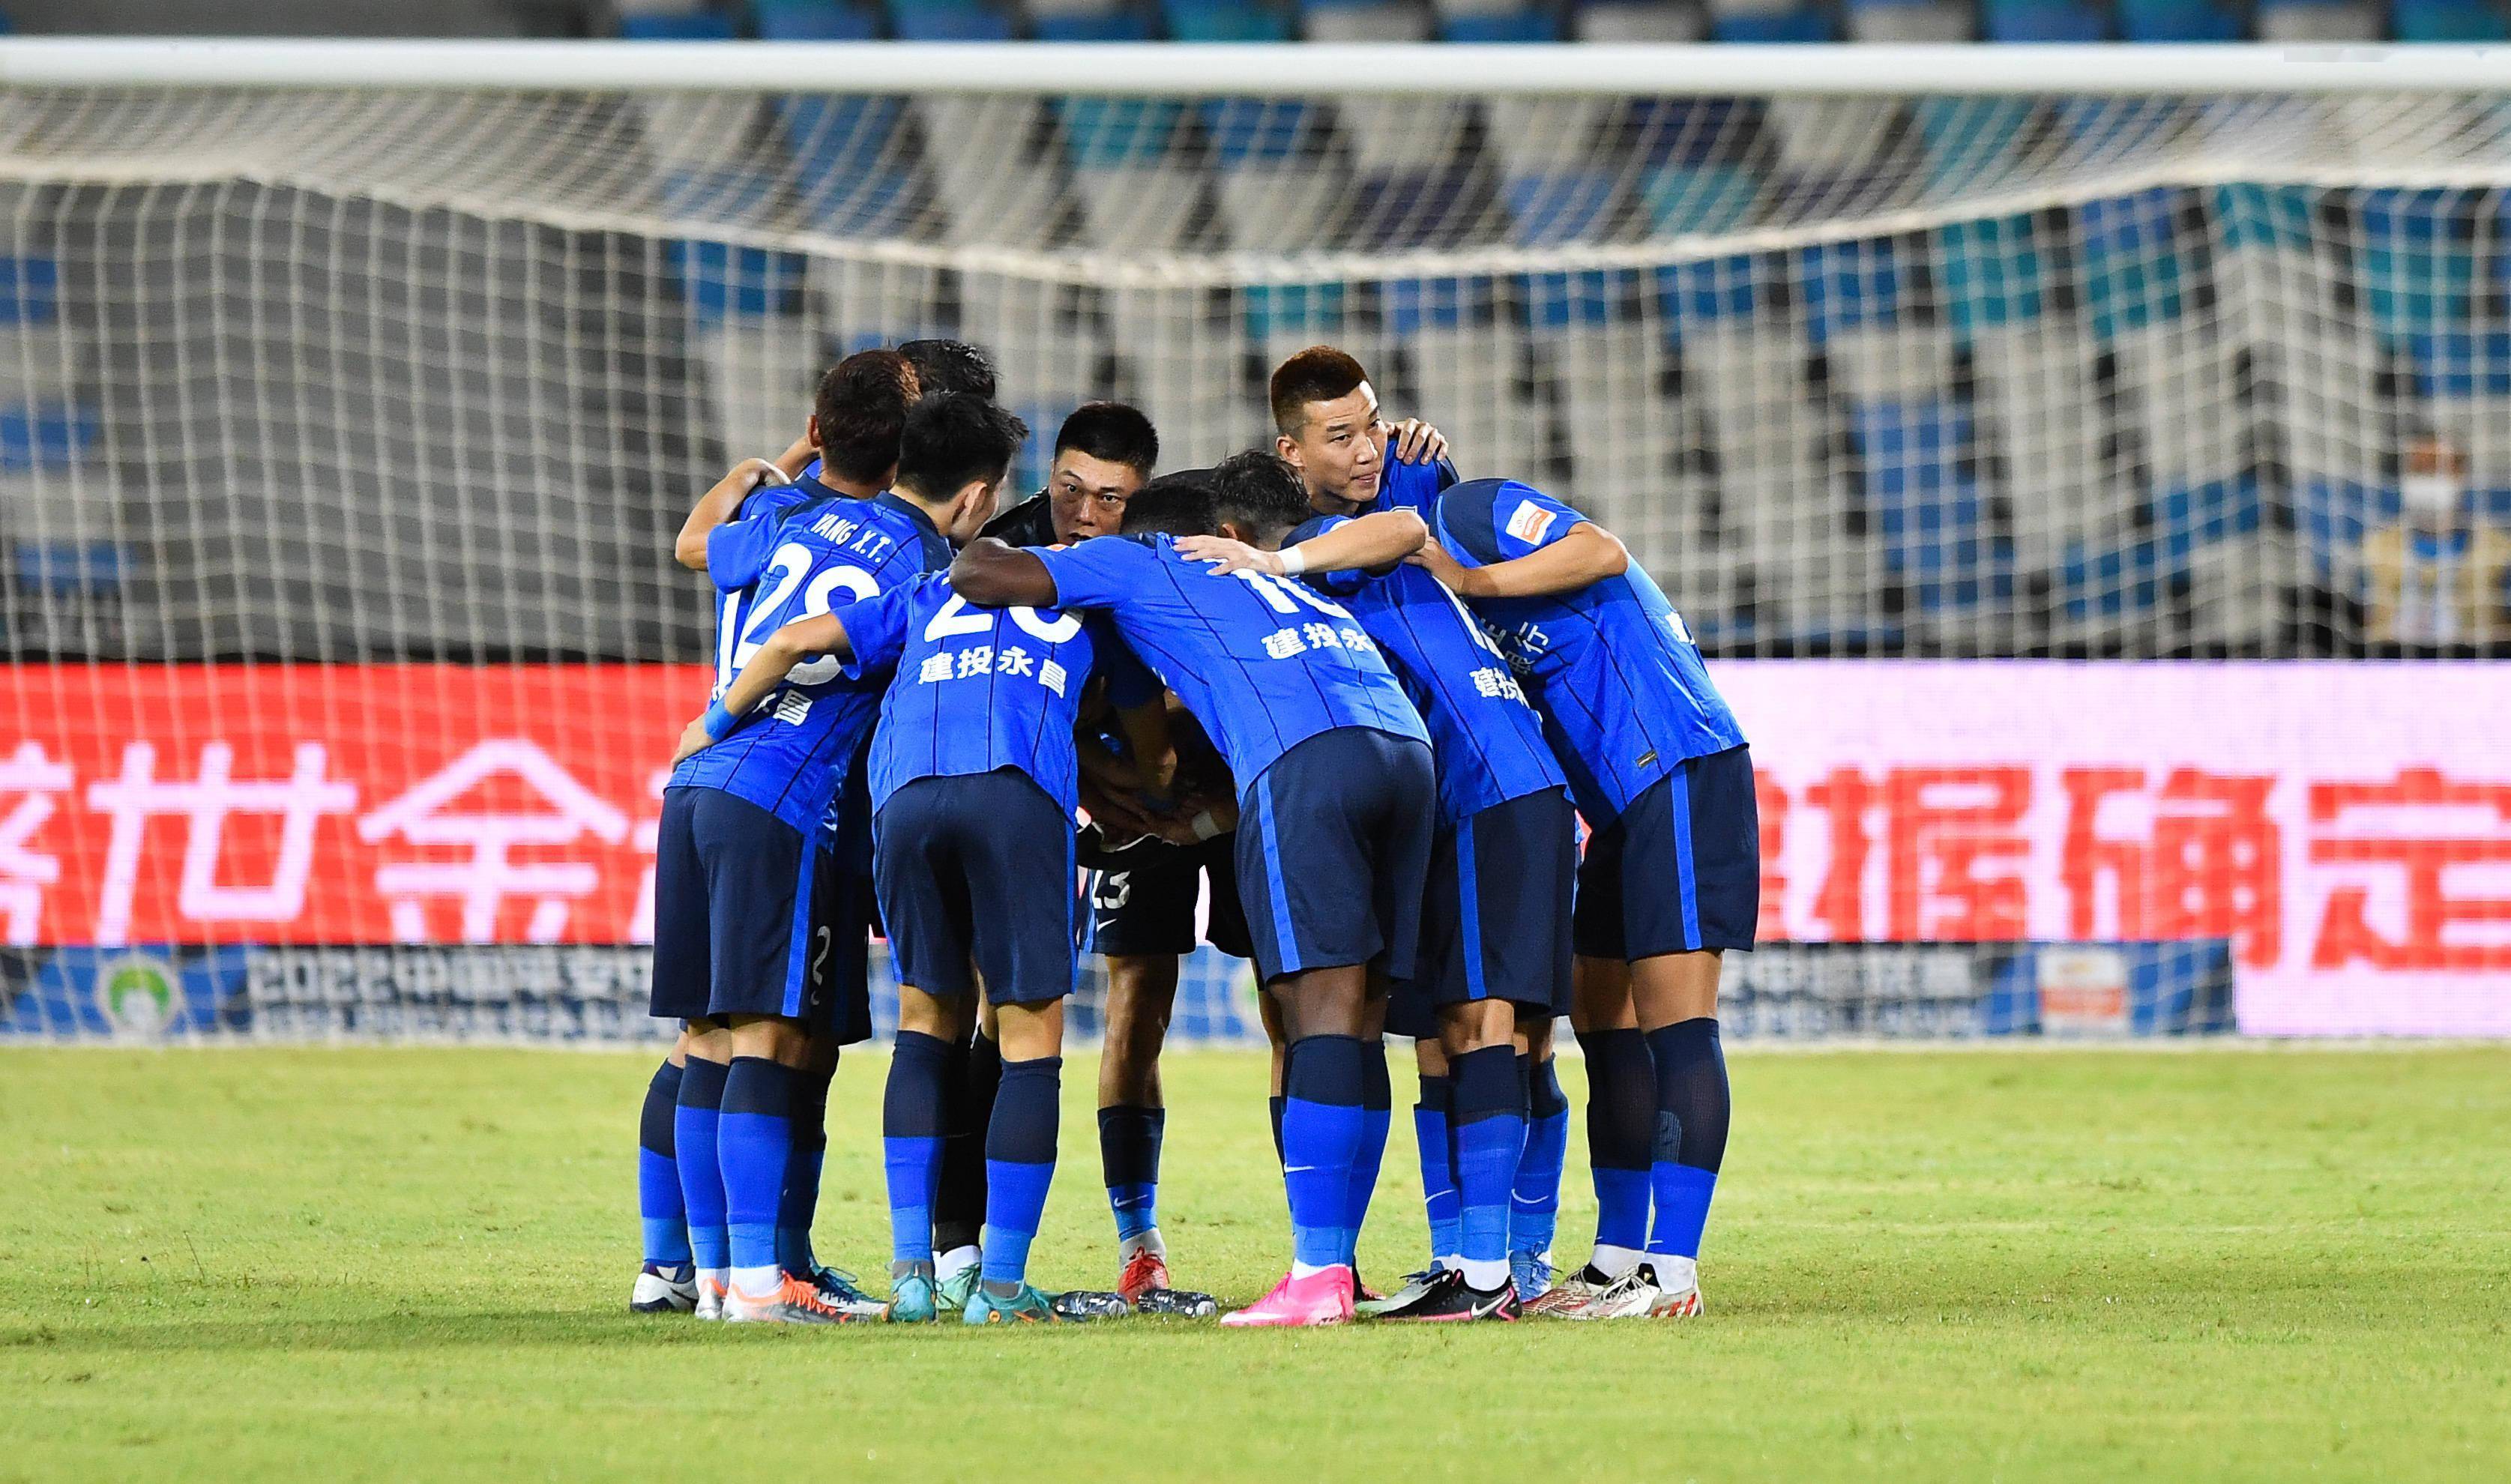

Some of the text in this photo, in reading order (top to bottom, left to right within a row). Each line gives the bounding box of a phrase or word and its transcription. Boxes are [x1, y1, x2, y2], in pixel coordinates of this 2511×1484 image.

[810, 513, 859, 545] YANG
[917, 645, 1067, 699] 建投永昌
[0, 738, 658, 946] 世金
[1754, 766, 2511, 969] 据确定
